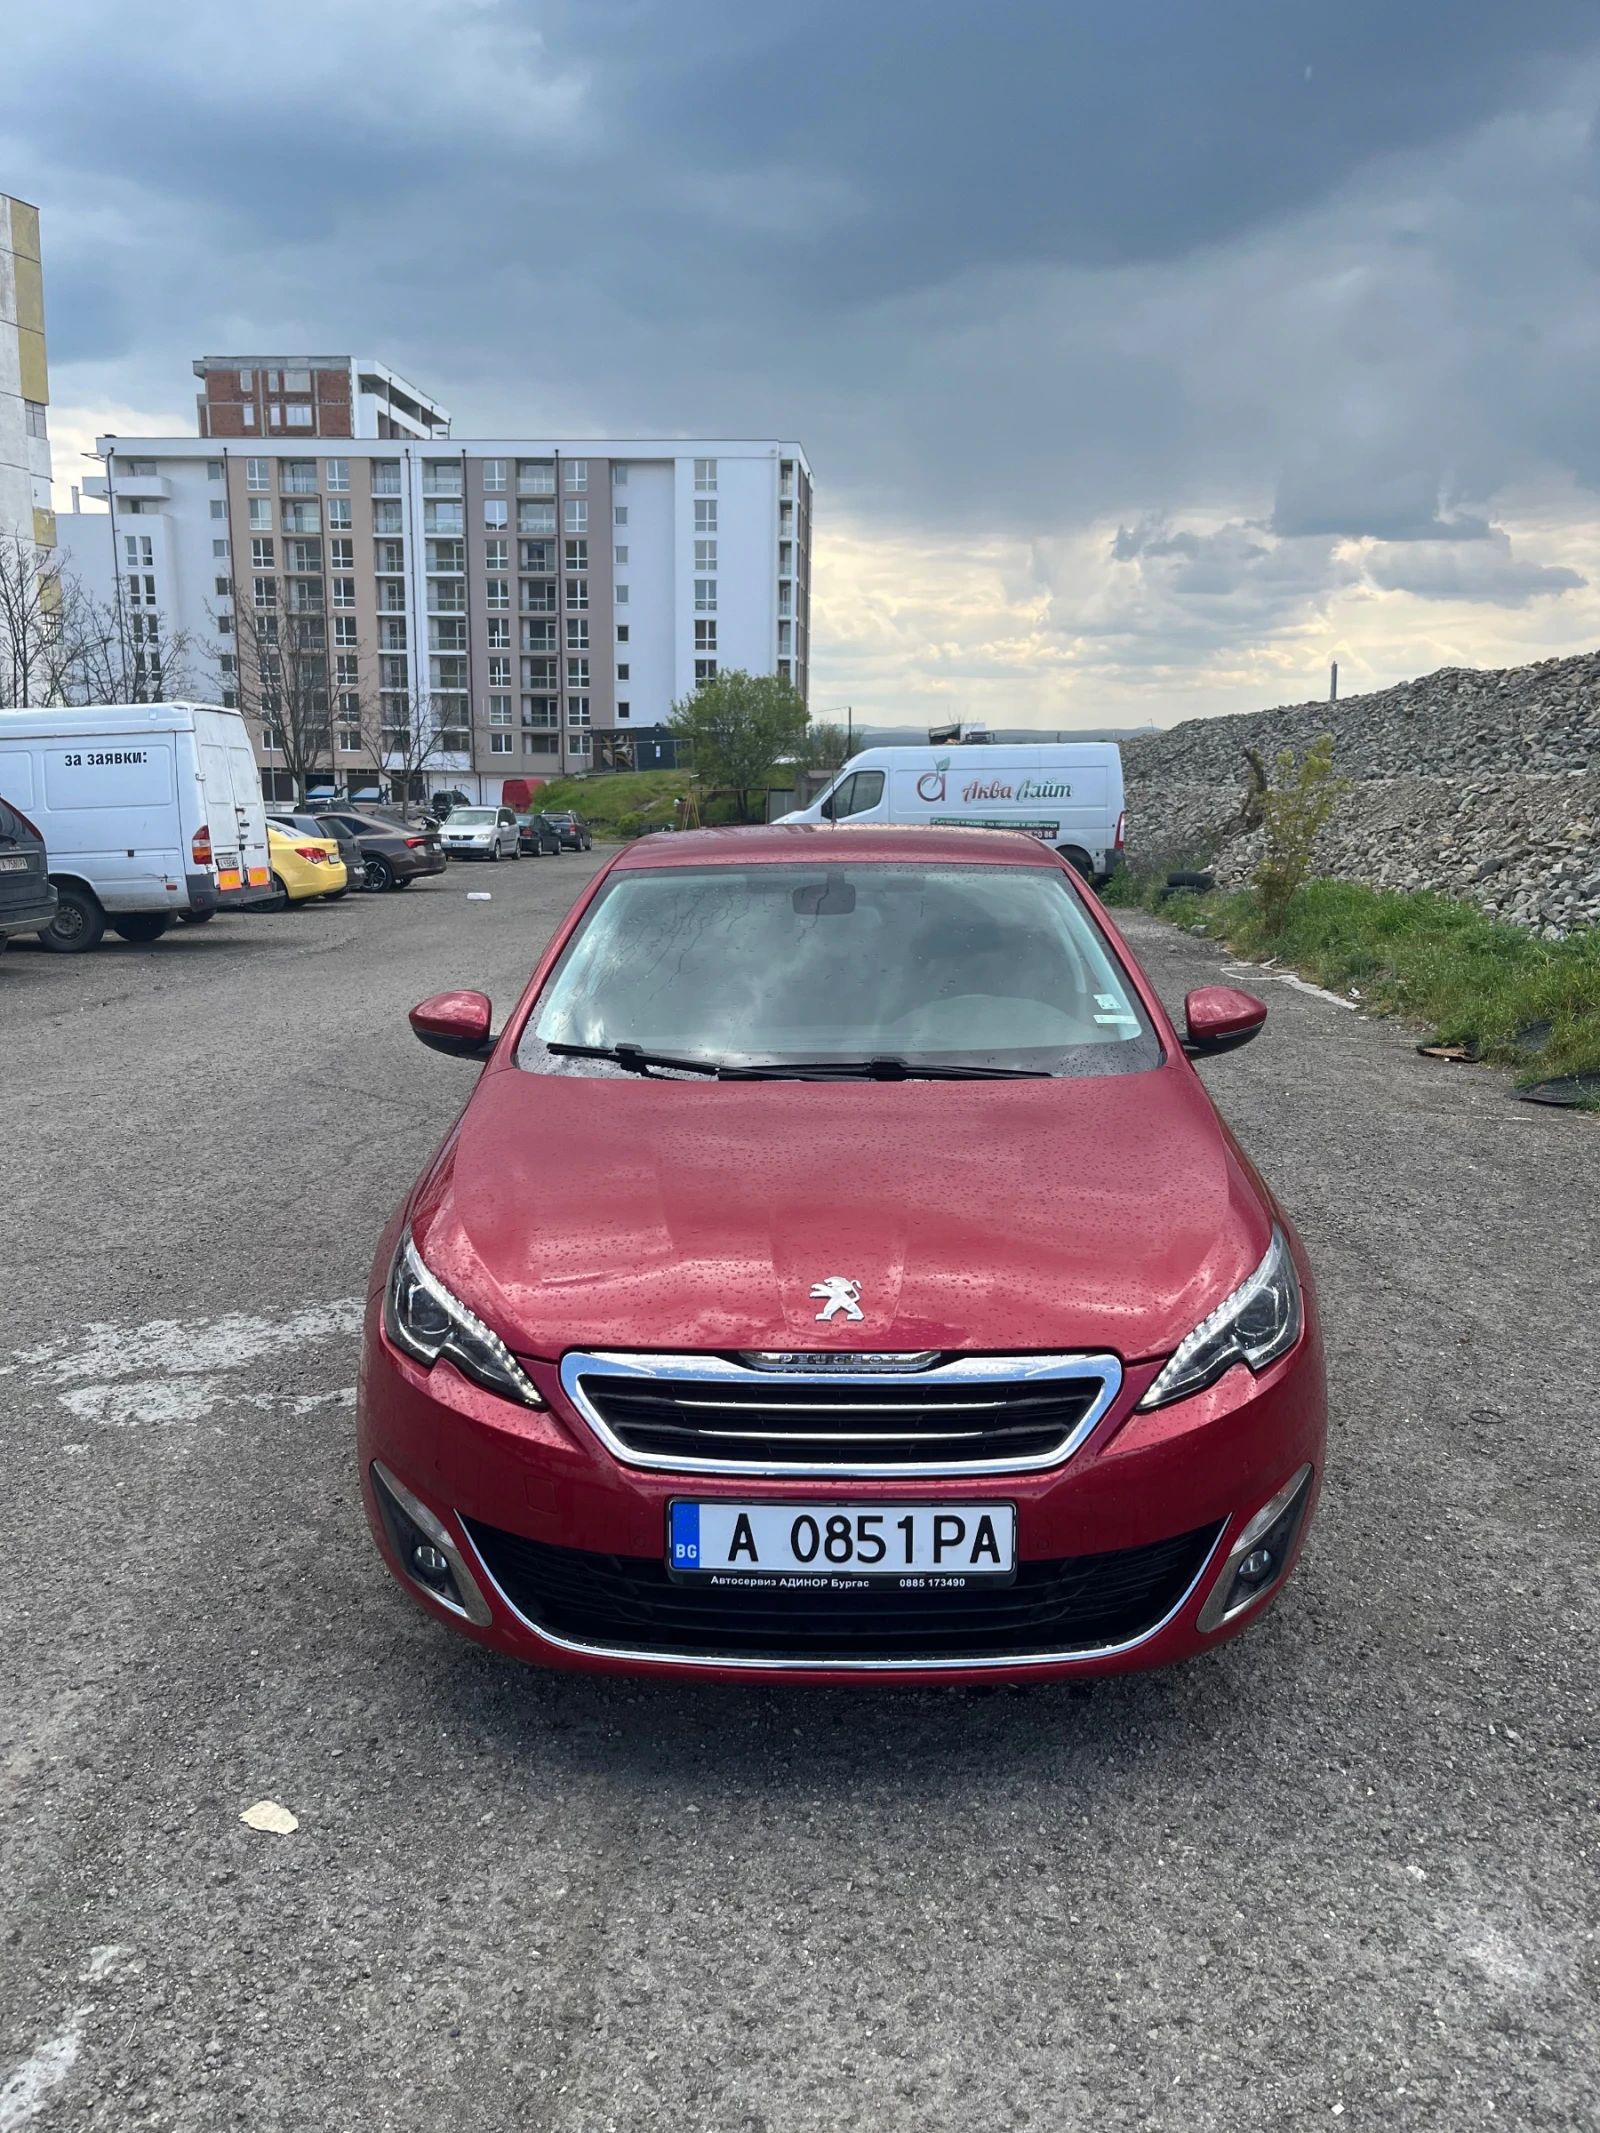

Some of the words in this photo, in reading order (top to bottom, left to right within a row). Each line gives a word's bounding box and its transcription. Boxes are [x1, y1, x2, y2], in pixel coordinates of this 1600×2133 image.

[64, 754, 82, 767] за
[86, 751, 147, 766] заявки:
[962, 778, 1012, 803] Аква
[1015, 778, 1072, 802] Лайт
[779, 1354, 899, 1365] PEUGEOT
[728, 1513, 759, 1562] A
[790, 1514, 914, 1564] 0851
[675, 1544, 698, 1559] BG
[711, 1575, 777, 1587] Автосервиз
[779, 1577, 828, 1588] АДИНОР
[831, 1578, 869, 1590] Бургас
[899, 1578, 925, 1588] 0885
[928, 1578, 966, 1588] 173490
